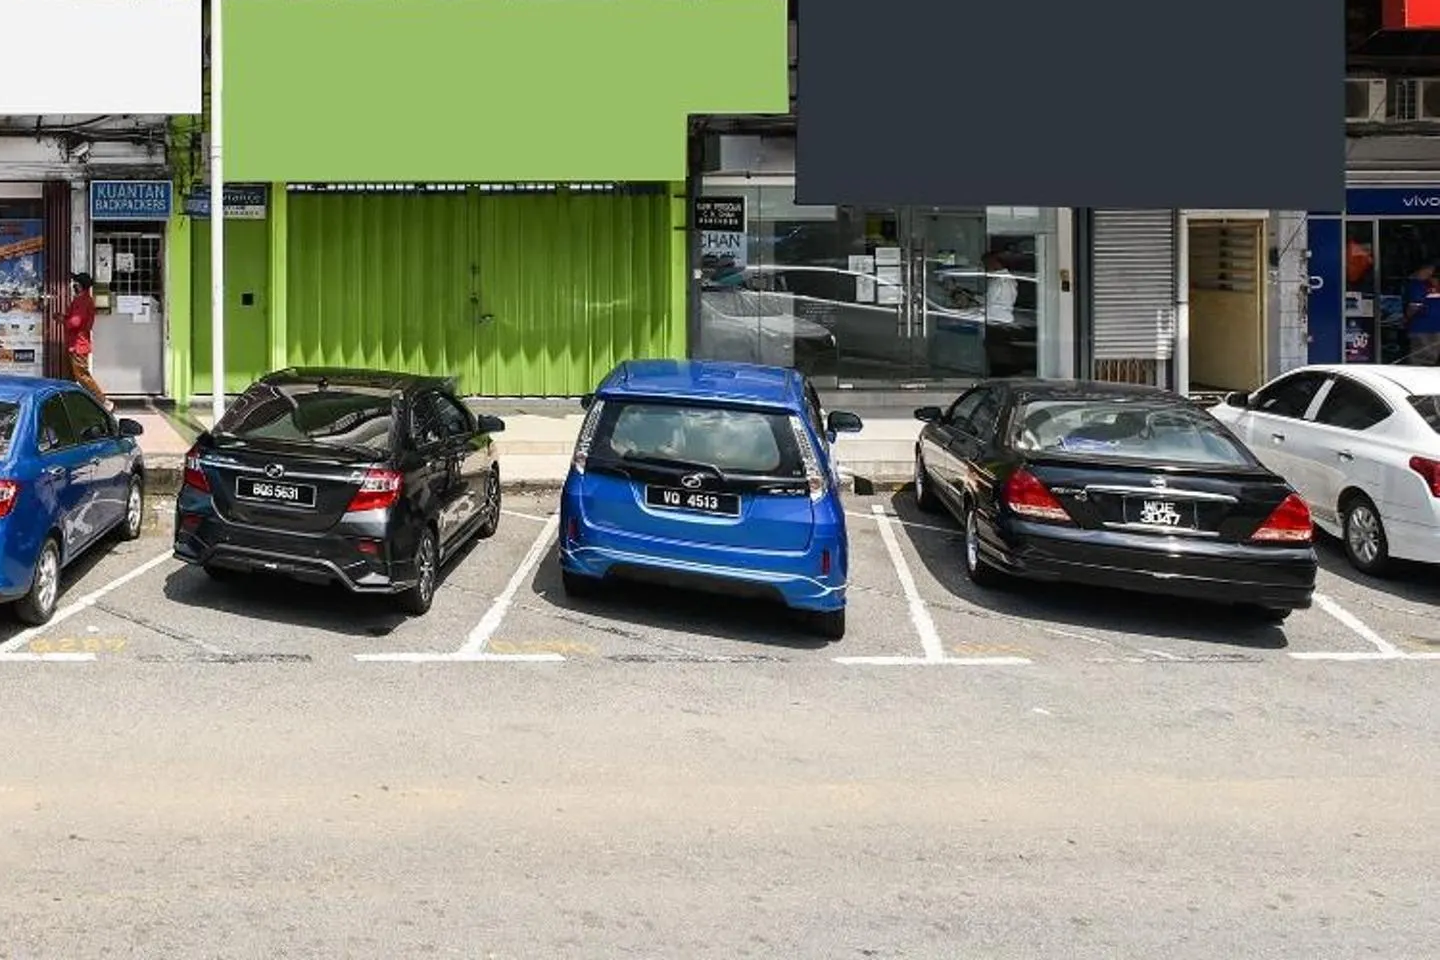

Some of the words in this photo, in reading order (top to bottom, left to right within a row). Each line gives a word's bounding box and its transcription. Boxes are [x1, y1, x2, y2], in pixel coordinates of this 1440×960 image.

[97, 183, 165, 199] KUANTAN
[96, 199, 166, 210] BACKPACKERS
[1403, 196, 1440, 206] vivo
[687, 495, 719, 510] 4513
